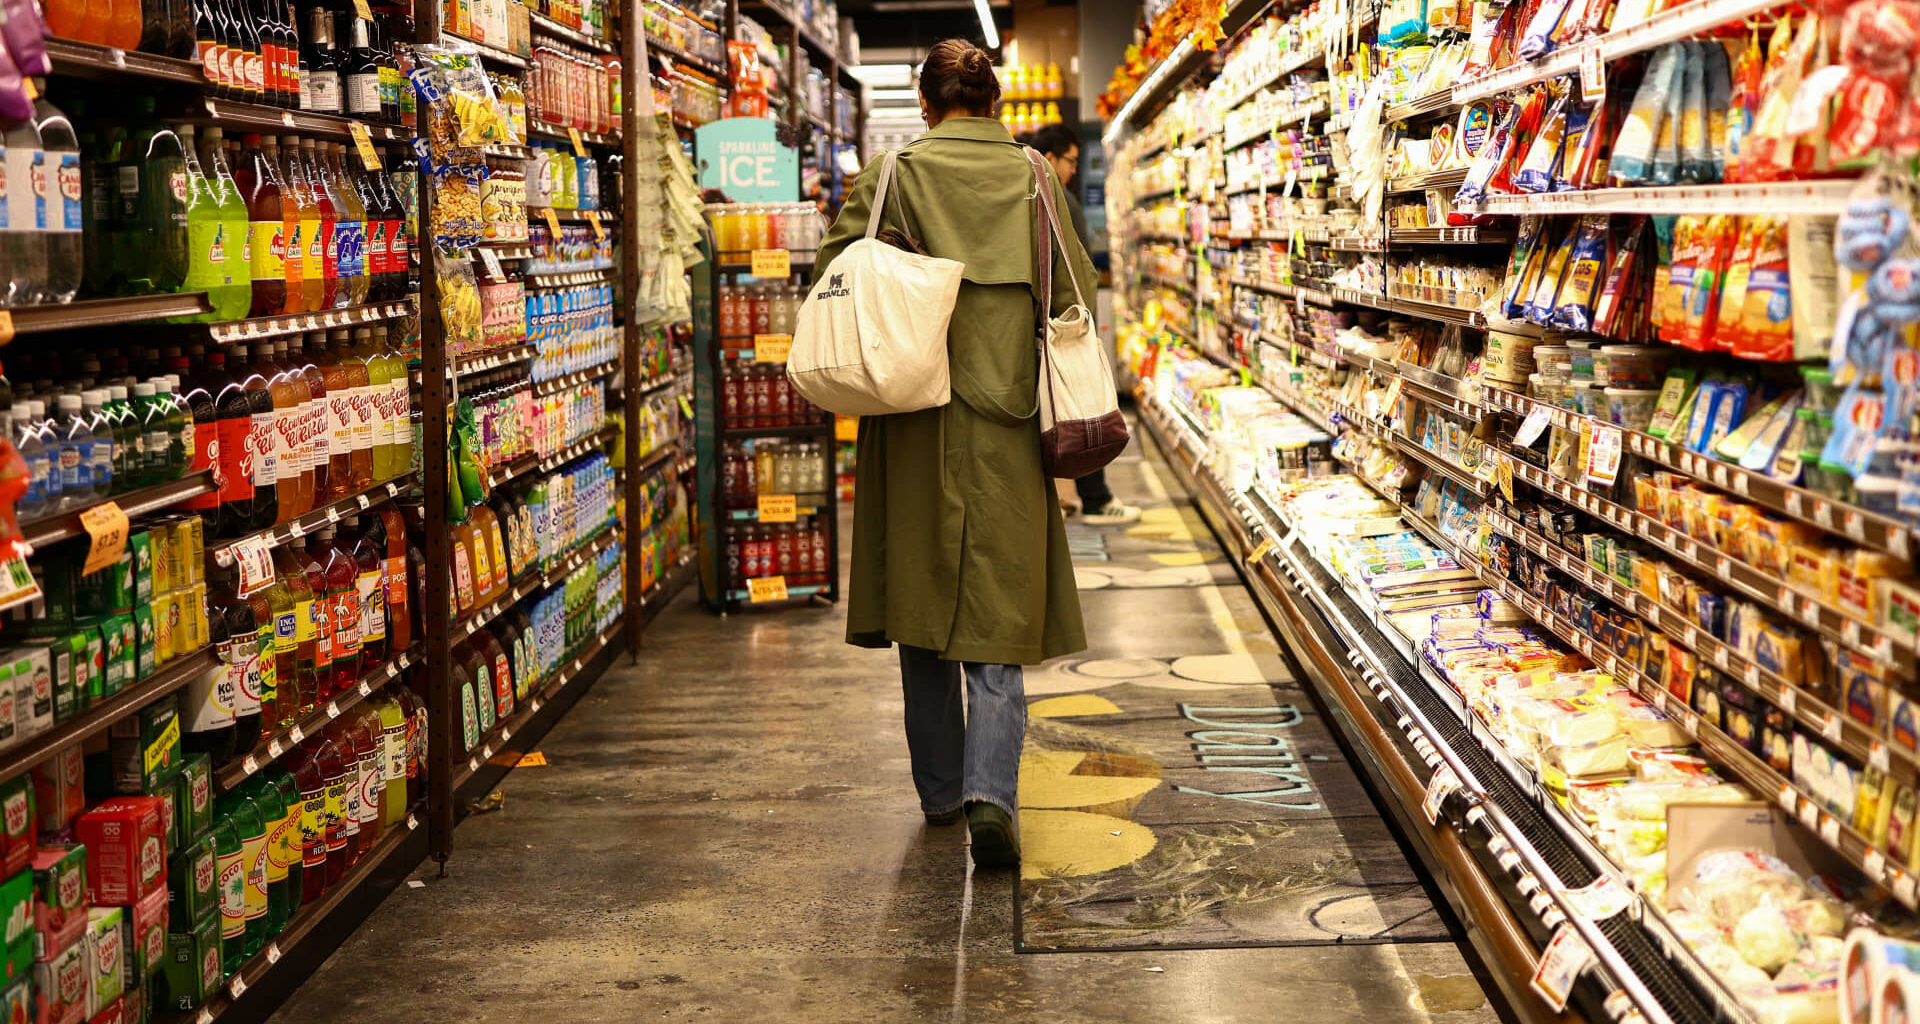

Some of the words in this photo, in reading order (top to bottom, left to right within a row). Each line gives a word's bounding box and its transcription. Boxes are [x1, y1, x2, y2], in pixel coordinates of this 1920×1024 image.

[720, 141, 776, 154] SPARKLING
[720, 155, 777, 187] ICE
[817, 288, 850, 301] STANLEY
[1171, 703, 1328, 811] Dairy
